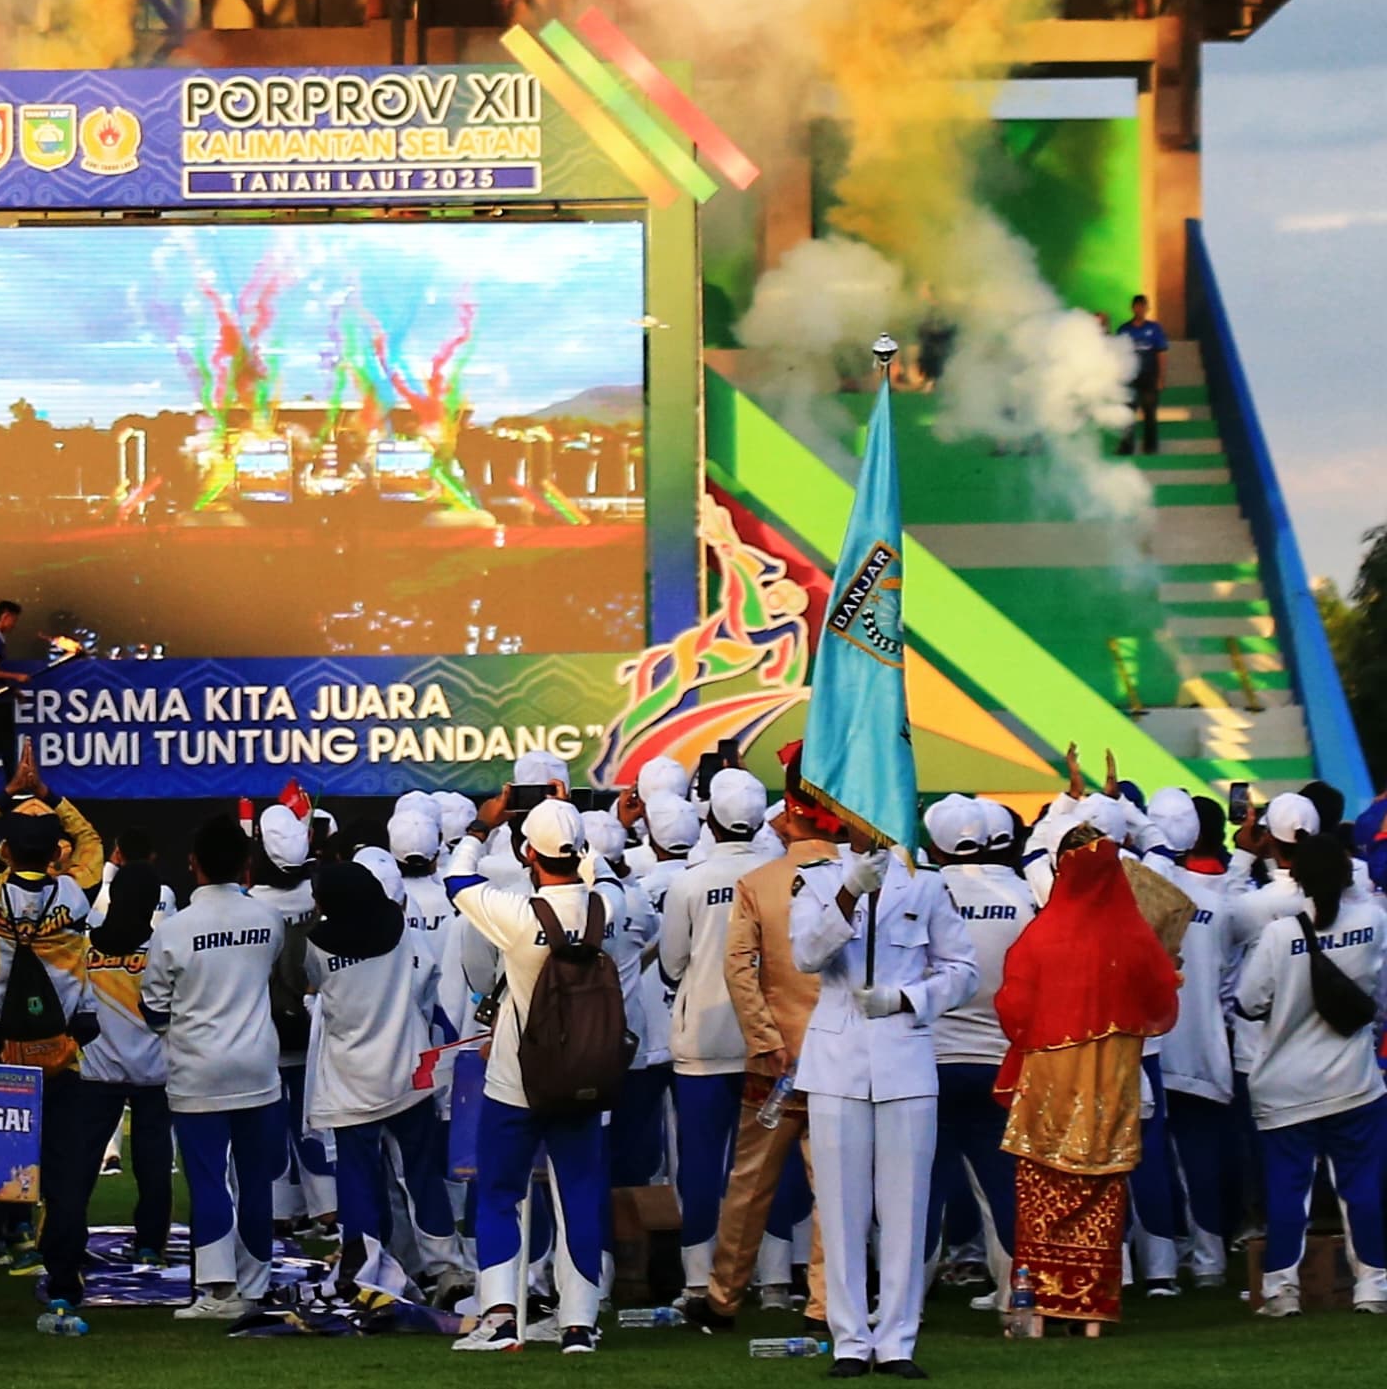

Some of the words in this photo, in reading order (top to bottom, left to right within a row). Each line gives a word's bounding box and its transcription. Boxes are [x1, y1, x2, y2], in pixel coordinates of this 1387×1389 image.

[185, 76, 455, 125] PORPROV
[468, 74, 541, 124] XII
[184, 130, 395, 162] KALIMANTAN
[399, 127, 540, 159] SELATAN
[232, 172, 330, 191] TANAH
[341, 171, 414, 190] LAUT
[422, 169, 494, 188] 2025
[833, 550, 889, 629] BANJAR
[205, 686, 297, 722] KITA
[311, 684, 451, 720] JUARA
[40, 732, 140, 767] BUMI
[154, 728, 357, 765] TUNTUNG
[960, 906, 1017, 920] NJAR
[193, 928, 270, 952] BANJAR
[1291, 927, 1374, 955] BNJAR
